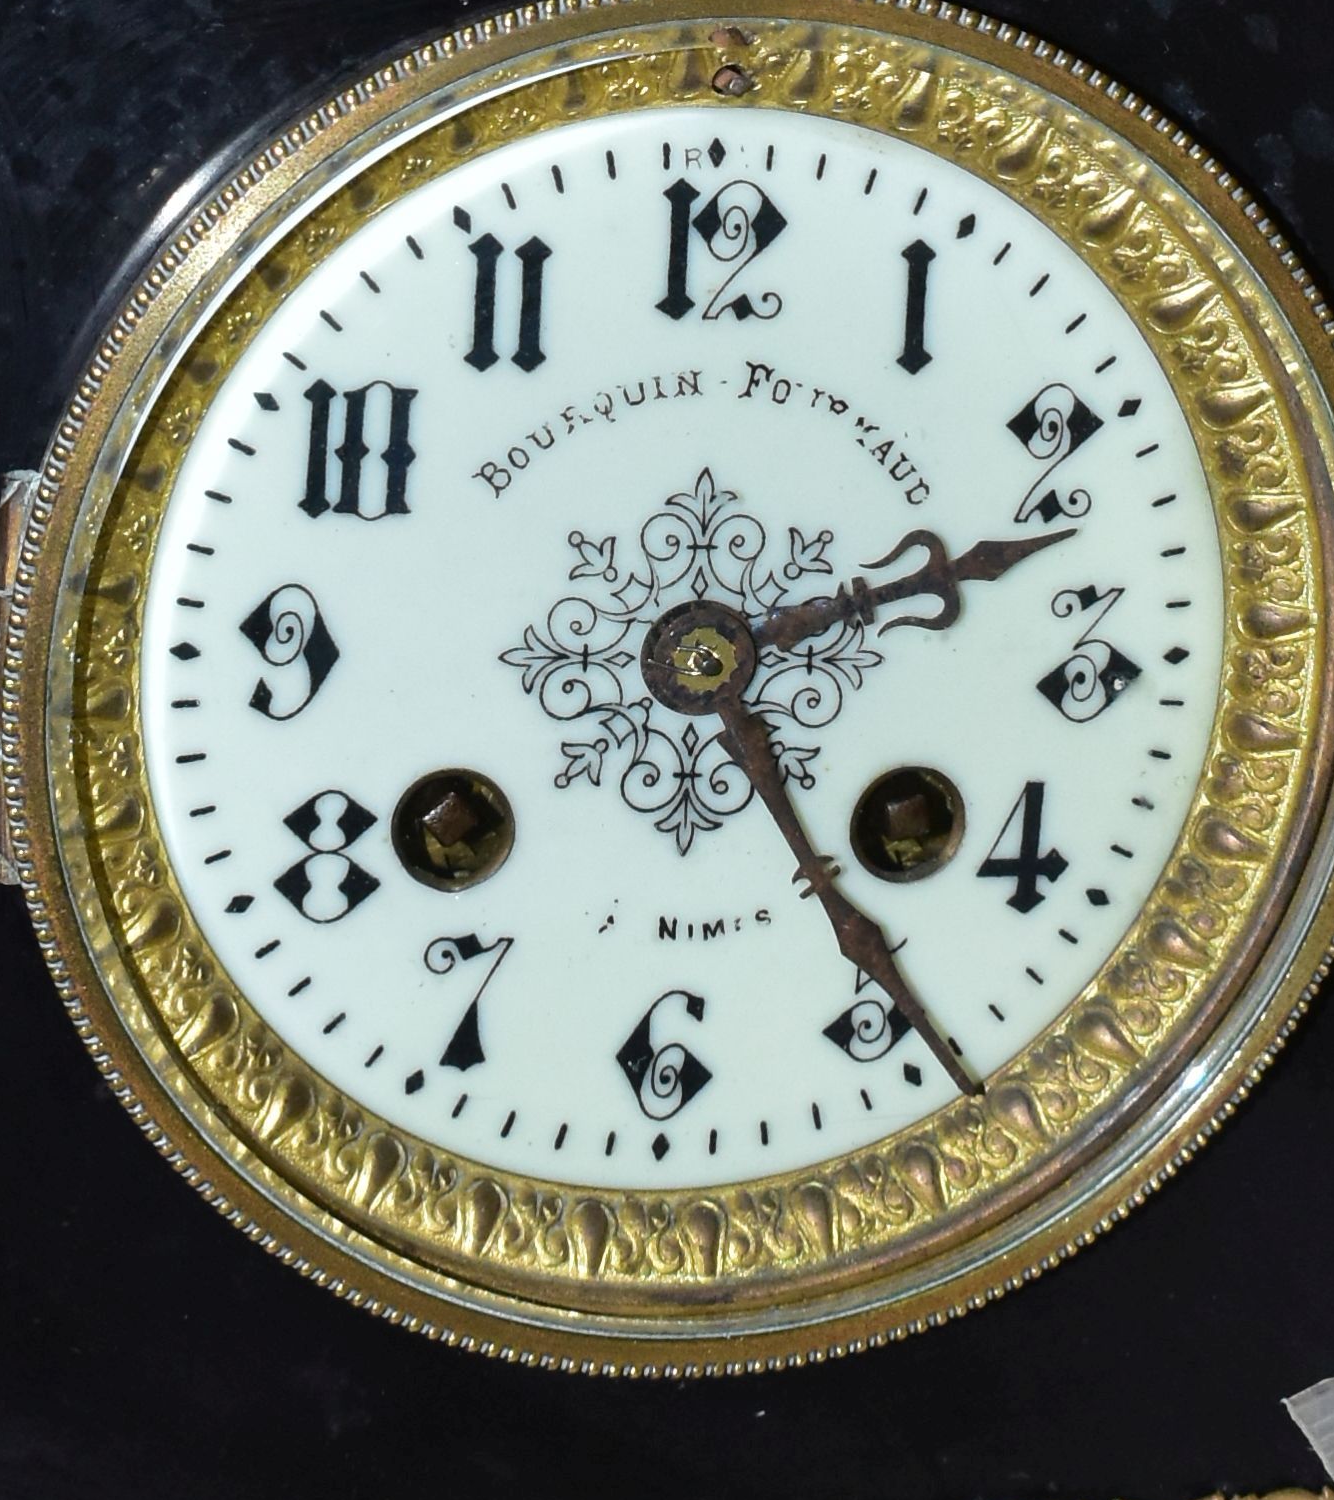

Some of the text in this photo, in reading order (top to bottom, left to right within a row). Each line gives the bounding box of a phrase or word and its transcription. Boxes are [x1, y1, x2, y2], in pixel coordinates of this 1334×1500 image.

[463, 232, 553, 373] 11
[654, 177, 788, 322] 12
[895, 238, 937, 376] 1
[297, 378, 419, 522] 10
[1005, 382, 1105, 524] 2
[238, 583, 340, 722] 9
[1035, 584, 1143, 724] 3
[273, 789, 381, 925] 8
[975, 780, 1070, 915] 4
[424, 933, 515, 1071] 7
[614, 989, 714, 1121] 6
